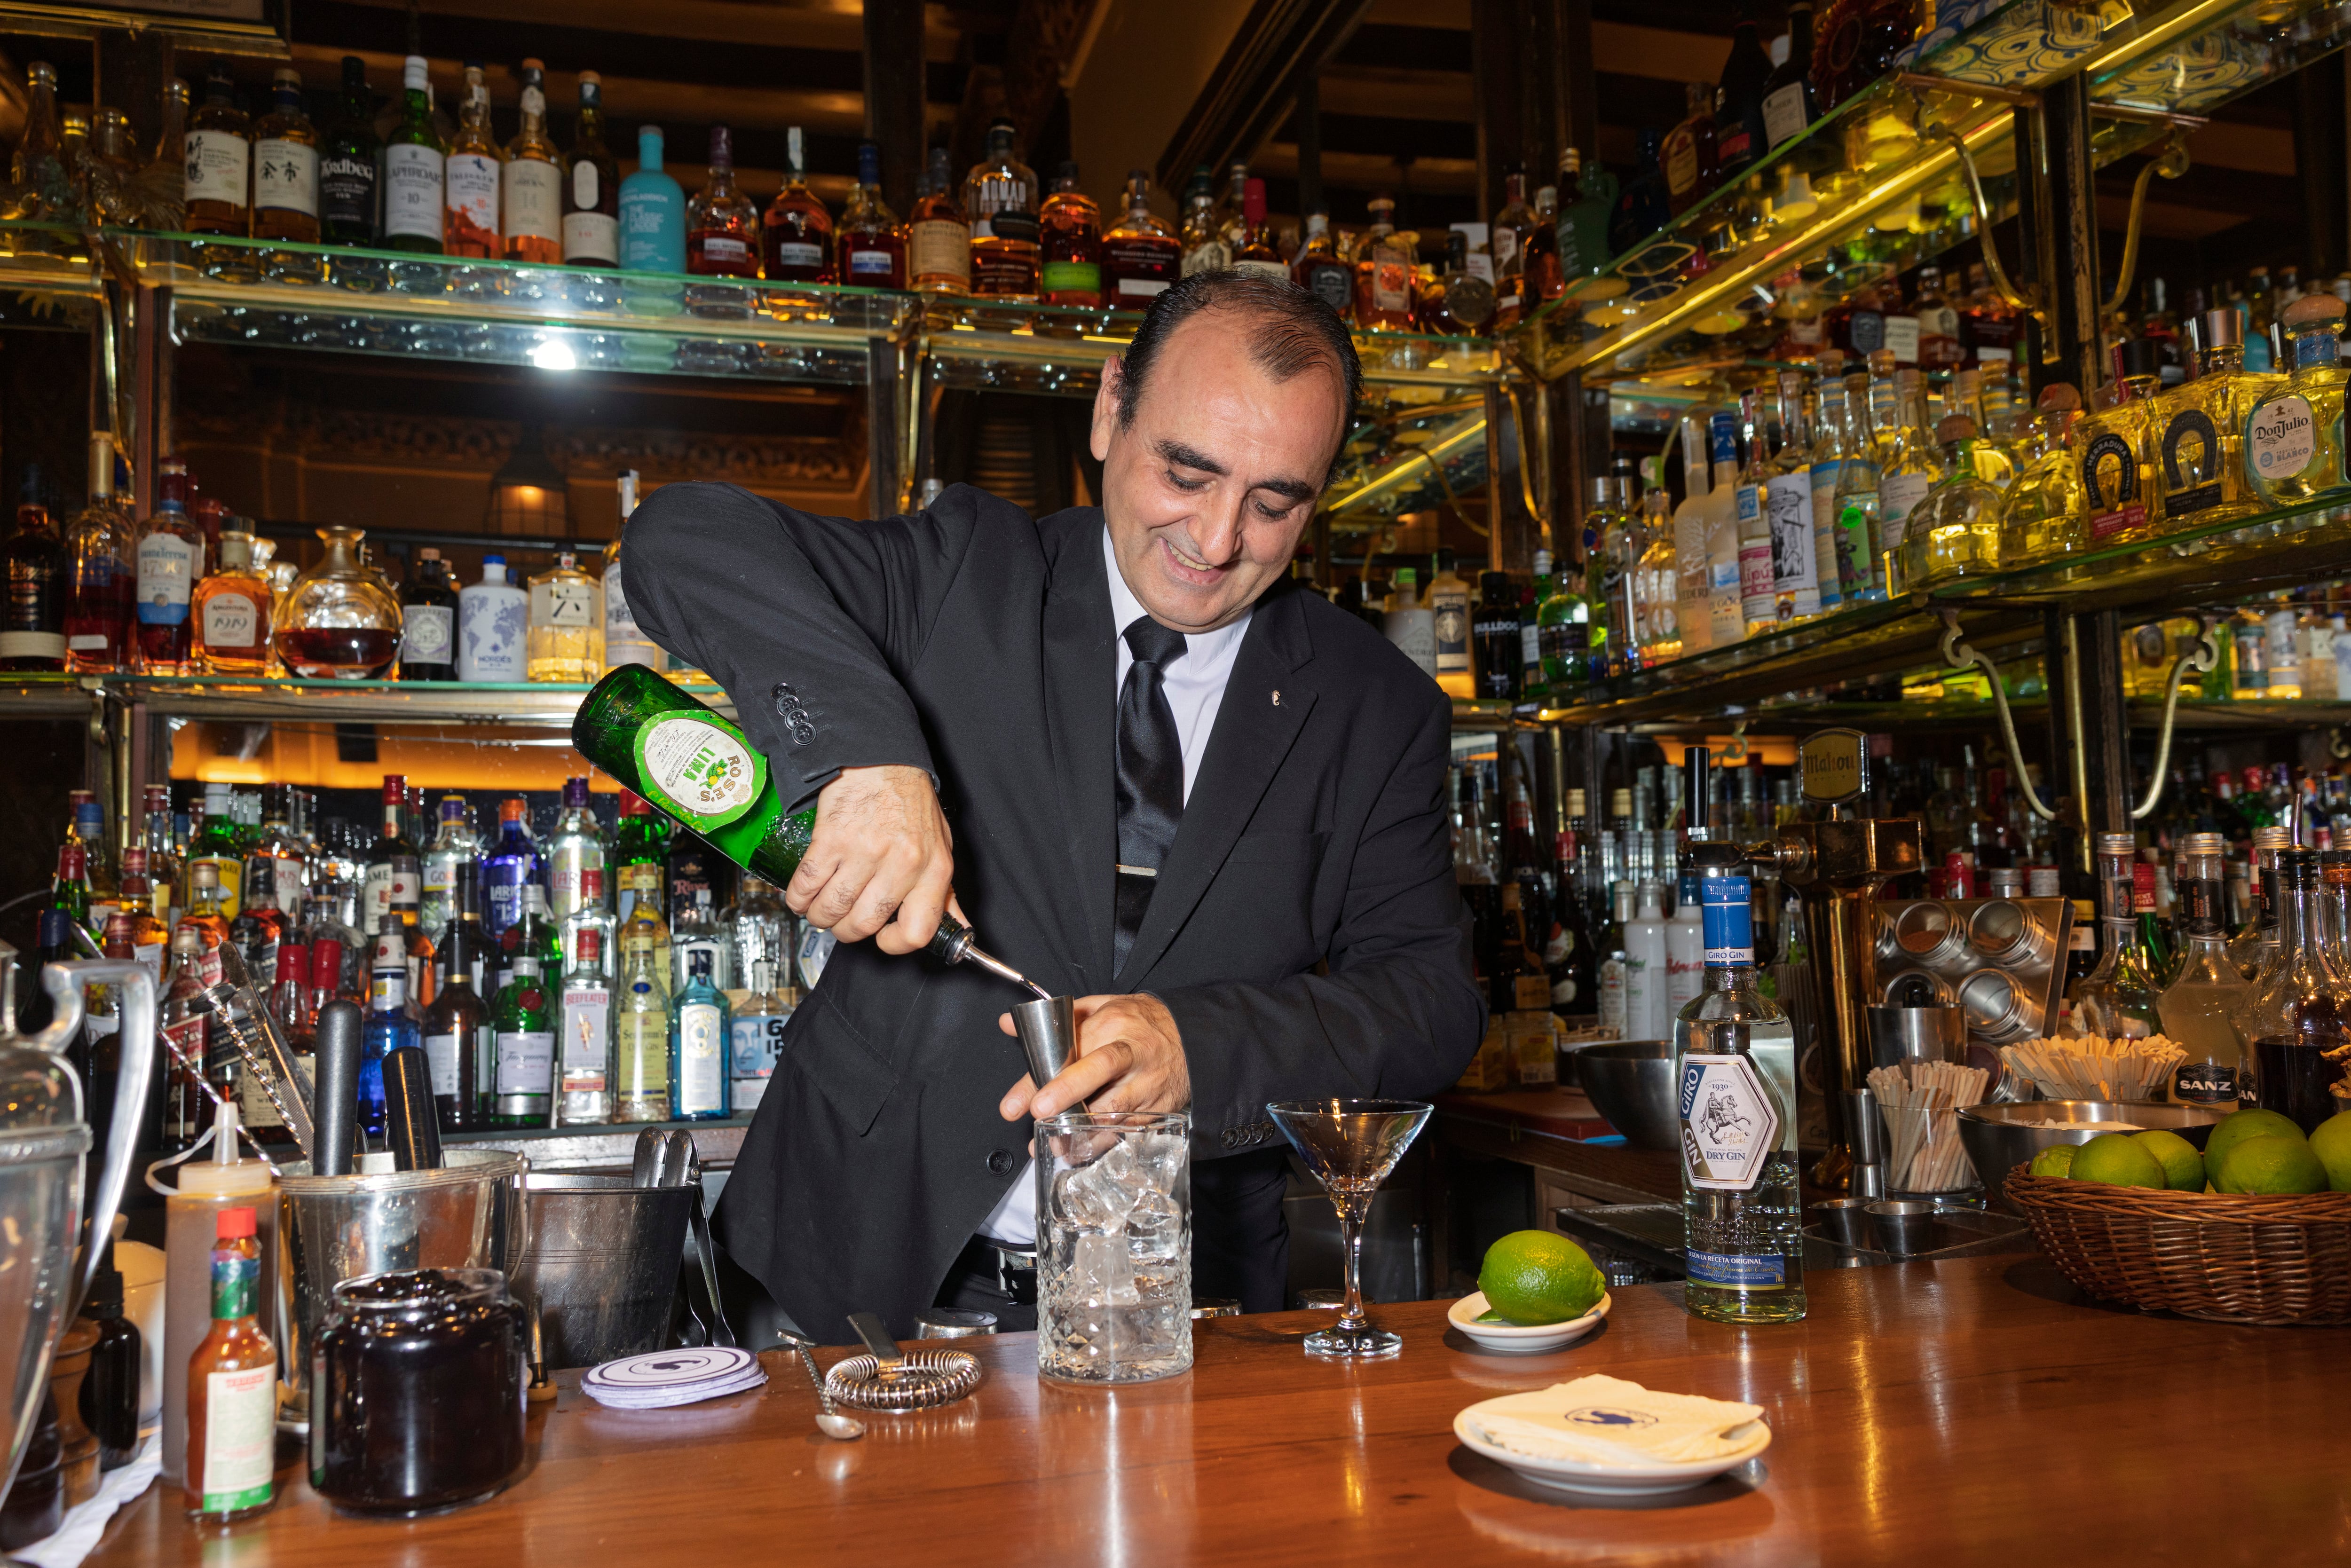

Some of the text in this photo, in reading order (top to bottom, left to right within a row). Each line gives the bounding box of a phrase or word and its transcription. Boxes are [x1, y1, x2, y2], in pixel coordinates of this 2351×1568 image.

[321, 159, 373, 181] Ardbeg
[2087, 441, 2127, 466] HERRADURA
[2277, 448, 2309, 462] BLANCO
[214, 615, 248, 631] 1919
[1474, 621, 1519, 634] BULLDOG
[683, 746, 716, 782] LIMA
[1805, 752, 1855, 774] Mahou
[367, 869, 389, 883] AME
[2193, 886, 2198, 896] de
[1708, 949, 1728, 959] GIRÓ
[565, 993, 608, 1006] BEEFEATER
[1681, 1068, 1699, 1115] GIRÓ
[2179, 1079, 2231, 1091] SANZ
[2239, 1089, 2256, 1102] AN
[1684, 1127, 1702, 1166] GIN
[1706, 1151, 1746, 1161] DRY GIN
[1688, 1251, 1700, 1259] SEGÚN
